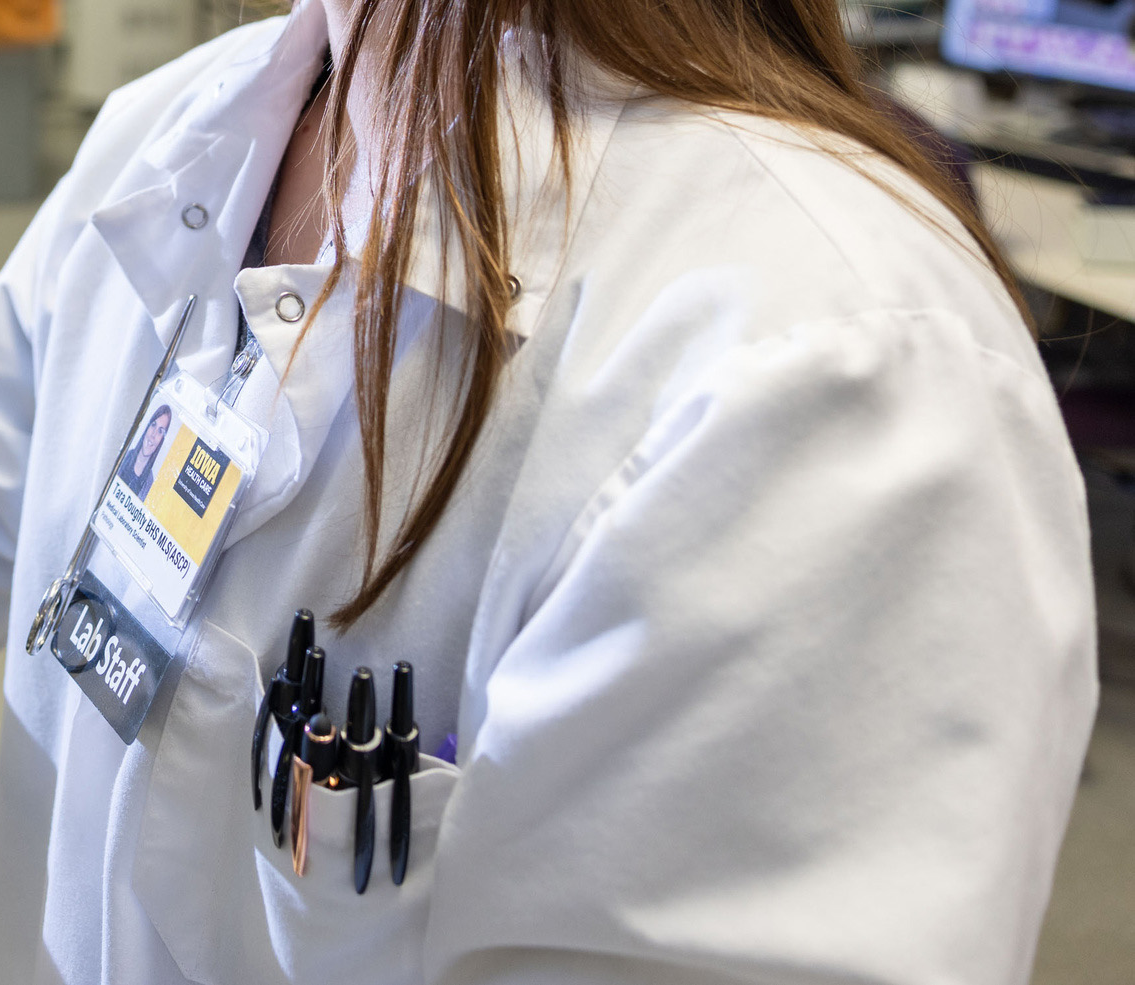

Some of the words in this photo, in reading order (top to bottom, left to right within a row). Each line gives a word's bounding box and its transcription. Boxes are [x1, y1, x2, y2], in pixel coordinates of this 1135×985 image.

[184, 464, 201, 486] HEALTH
[199, 479, 213, 496] CARE
[190, 445, 221, 485] IOWA
[106, 500, 118, 516] Medical
[116, 513, 133, 534] Laboratory
[132, 529, 147, 550] Scientist
[112, 482, 126, 504] Tara
[124, 495, 147, 530] Doughty
[145, 519, 160, 541] BHS
[157, 532, 191, 580] MLS(ASCP)
[69, 604, 104, 663] Lab
[95, 634, 147, 705] Staff
